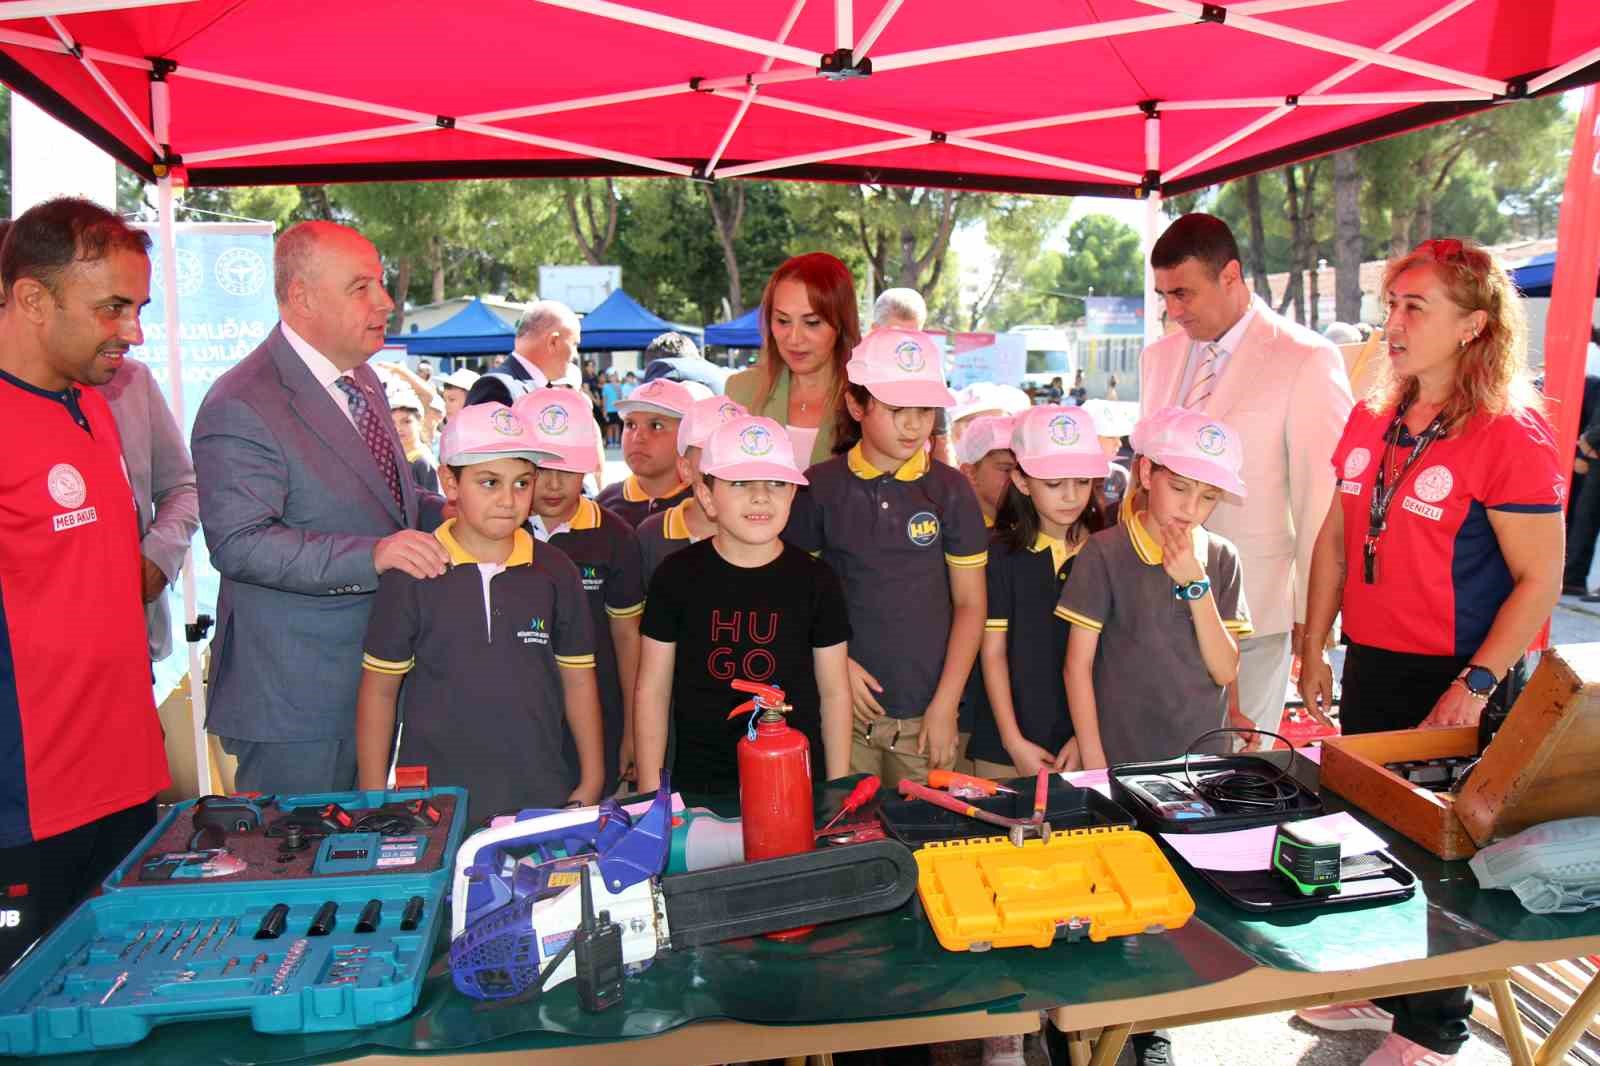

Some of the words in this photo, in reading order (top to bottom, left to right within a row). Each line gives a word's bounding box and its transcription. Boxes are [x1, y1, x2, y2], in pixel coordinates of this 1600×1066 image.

[55, 514, 75, 528] MEB
[76, 508, 96, 523] AKUB
[712, 609, 777, 644] HU
[708, 646, 776, 681] GO
